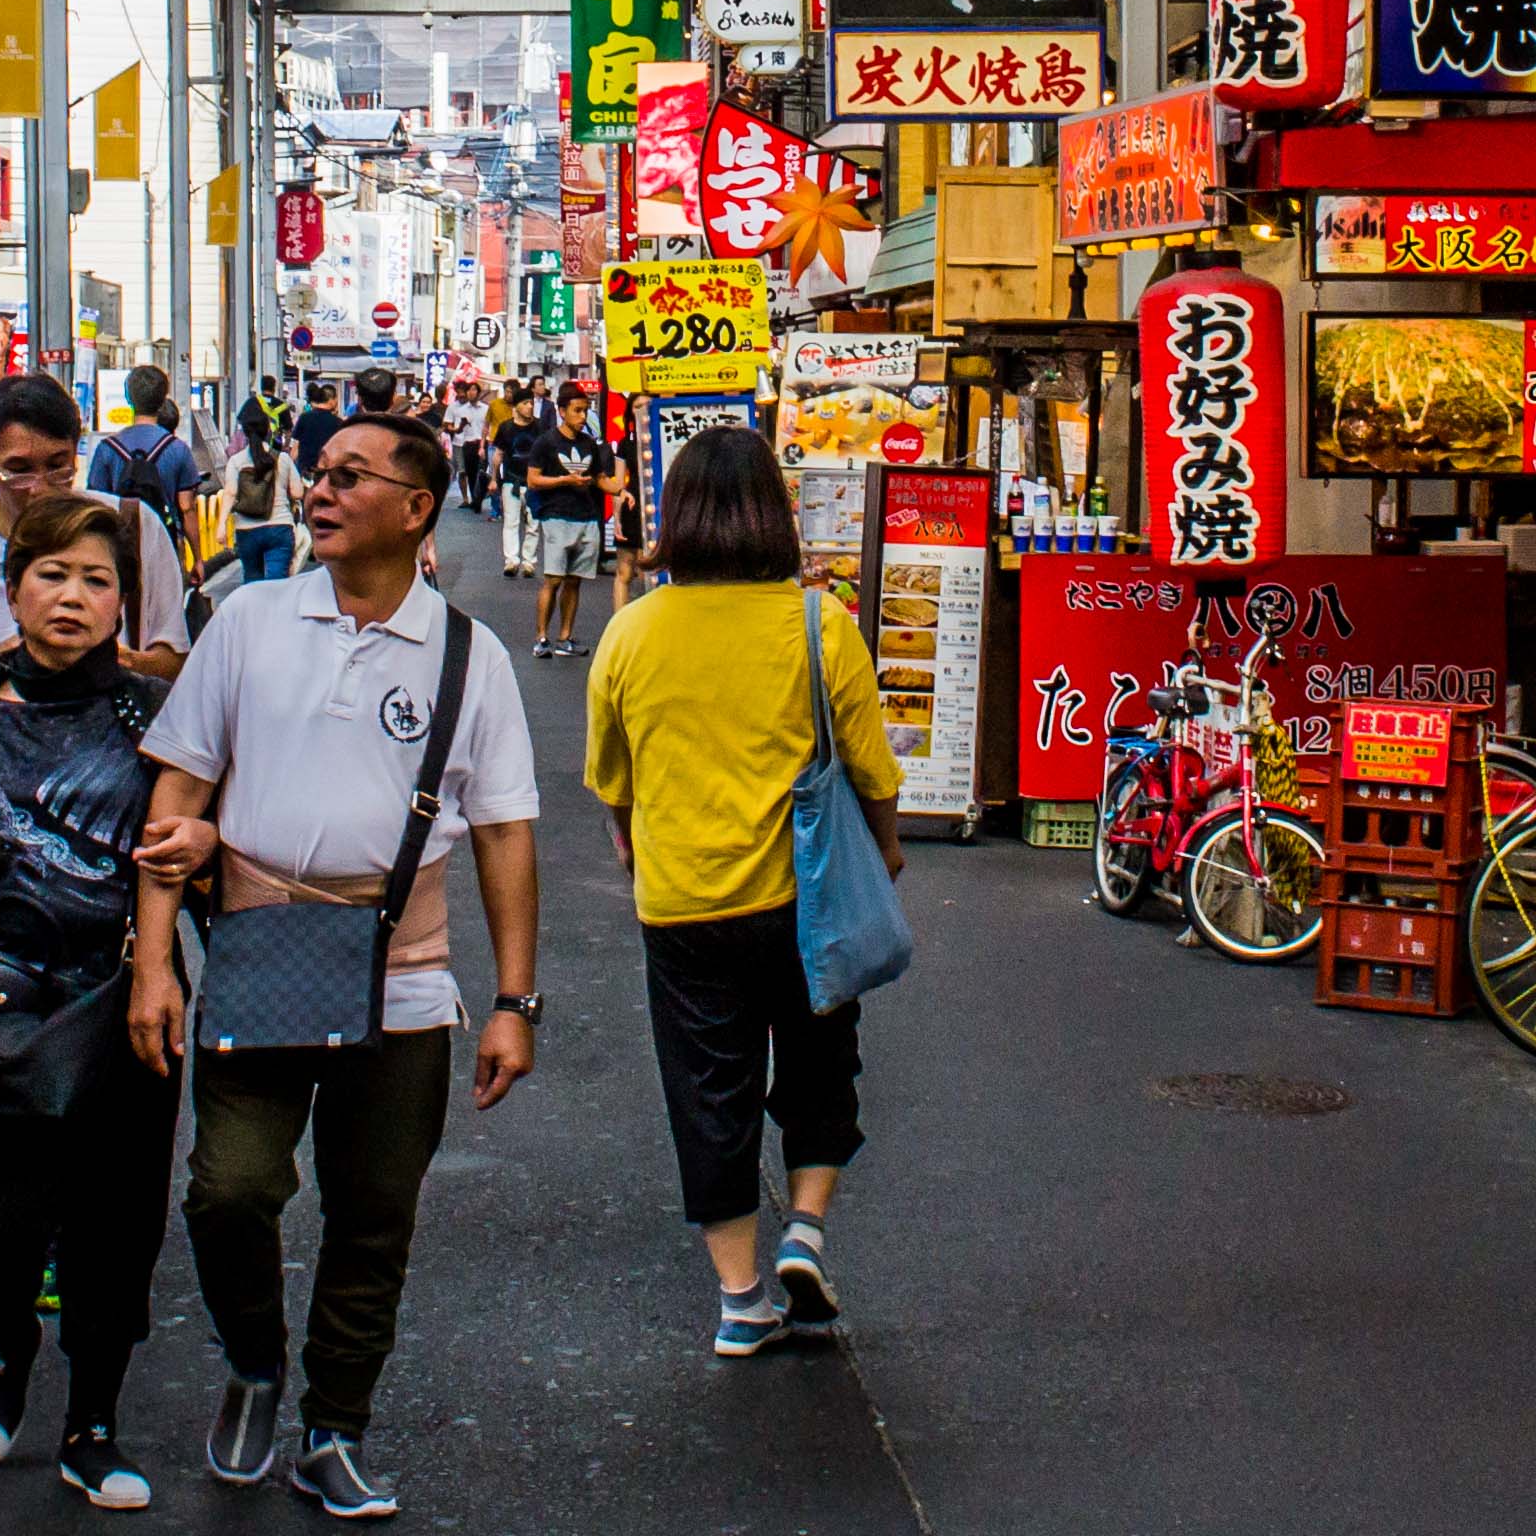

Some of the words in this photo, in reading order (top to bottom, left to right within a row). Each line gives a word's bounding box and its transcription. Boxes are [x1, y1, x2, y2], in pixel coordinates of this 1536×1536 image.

[754, 51, 786, 66] 1階
[847, 43, 1088, 109] 炭火焼鳥
[707, 121, 785, 250] はつせ
[1318, 205, 1386, 243] Asahi
[1406, 200, 1485, 223] 美味しい
[608, 268, 638, 303] 2
[648, 277, 755, 316] 飲み放題
[629, 313, 737, 362] 1,280
[1167, 292, 1258, 565] お好み焼
[1065, 579, 1184, 612] たこやき
[1305, 662, 1373, 703] 8個
[1379, 664, 1496, 706] 450円
